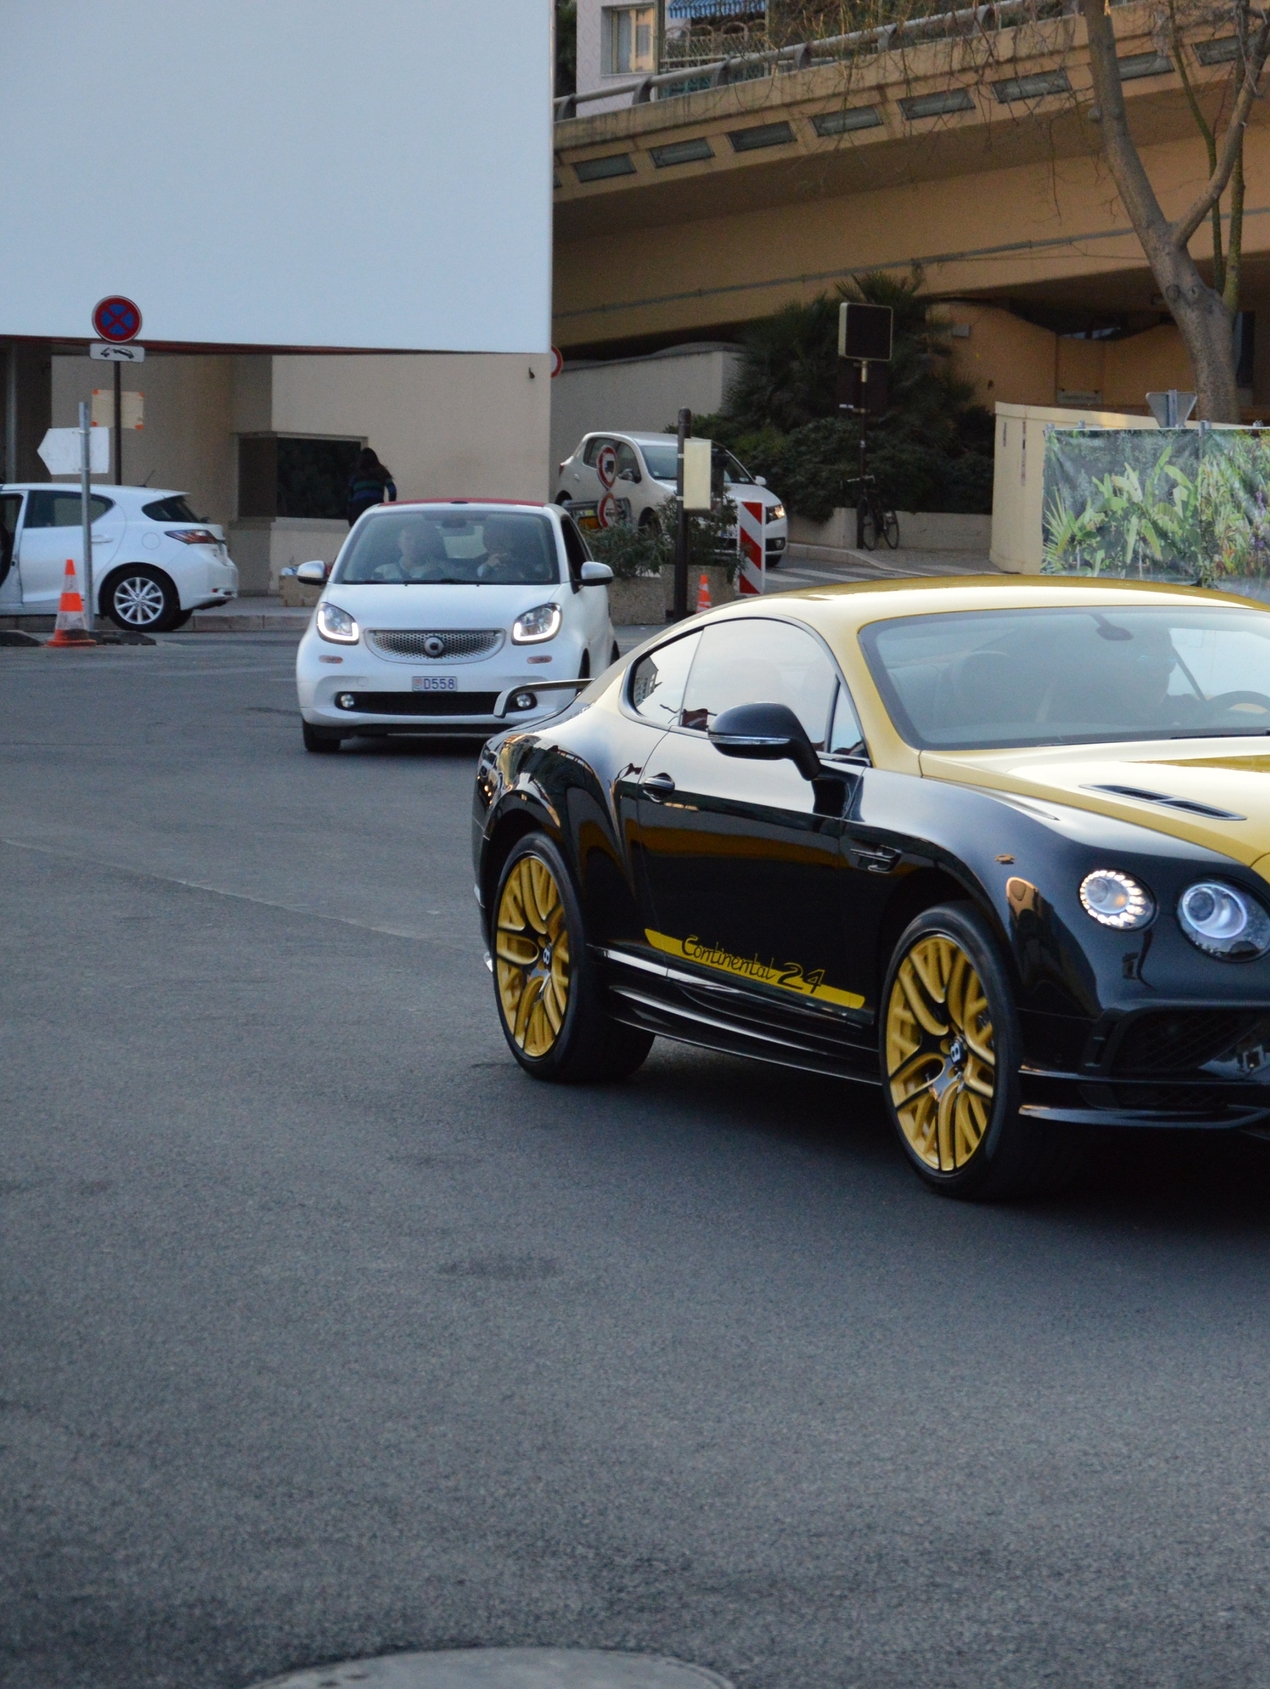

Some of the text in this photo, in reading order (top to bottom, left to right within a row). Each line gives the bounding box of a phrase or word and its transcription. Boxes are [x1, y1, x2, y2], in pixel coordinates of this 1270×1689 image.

[423, 678, 455, 690] D558
[681, 934, 825, 994] Continental 24
